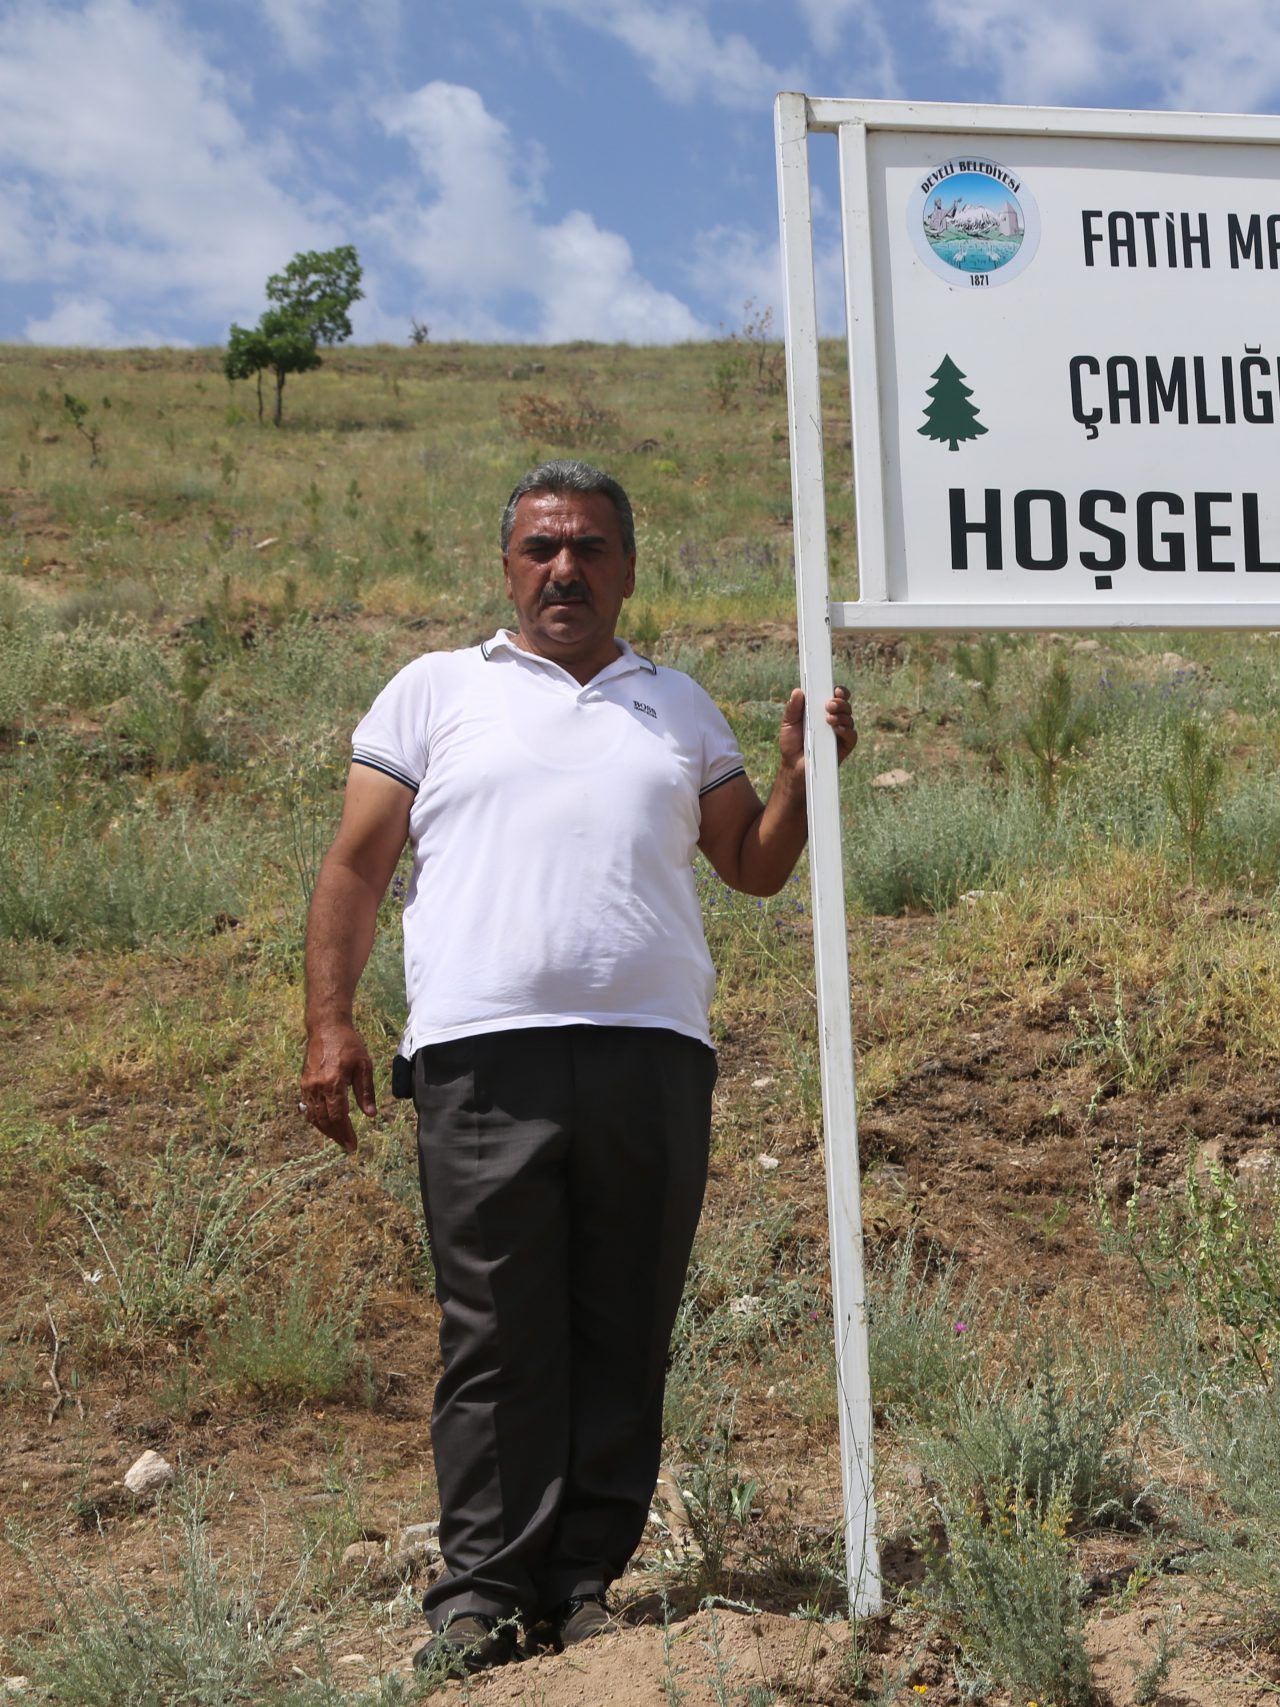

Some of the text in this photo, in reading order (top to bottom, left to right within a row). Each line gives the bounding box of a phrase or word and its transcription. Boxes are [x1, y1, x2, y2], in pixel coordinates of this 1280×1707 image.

[921, 161, 1021, 194] DEVELİ BELEDİYESİ
[1081, 210, 1210, 269] FATİH
[970, 274, 989, 287] 1871
